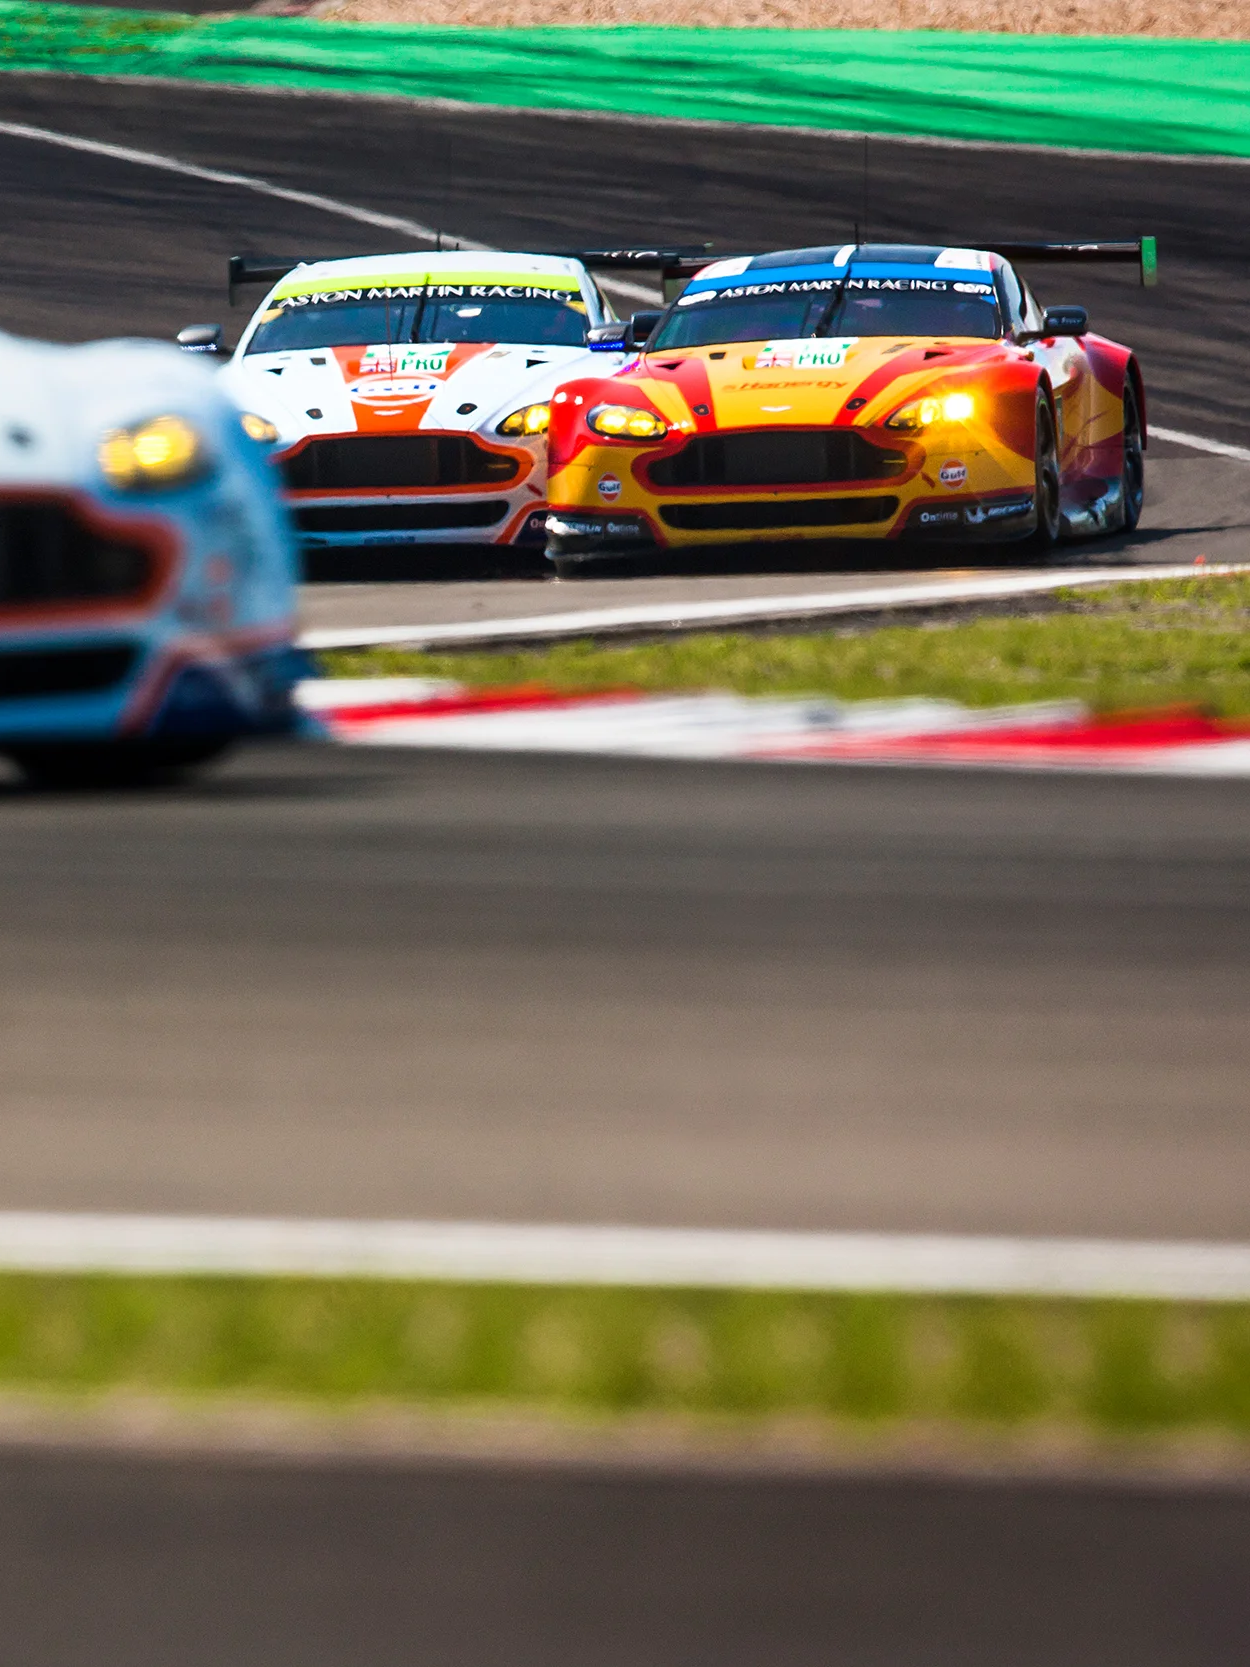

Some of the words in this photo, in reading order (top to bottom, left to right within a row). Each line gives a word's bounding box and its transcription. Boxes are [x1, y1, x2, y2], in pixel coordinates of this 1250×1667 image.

[277, 289, 363, 308] ASTON
[367, 285, 464, 300] MARTIN
[470, 285, 573, 302] RACING
[719, 283, 786, 299] ASTON
[868, 280, 948, 291] RACING
[940, 469, 966, 480] Gulf
[598, 482, 620, 492] Gulf
